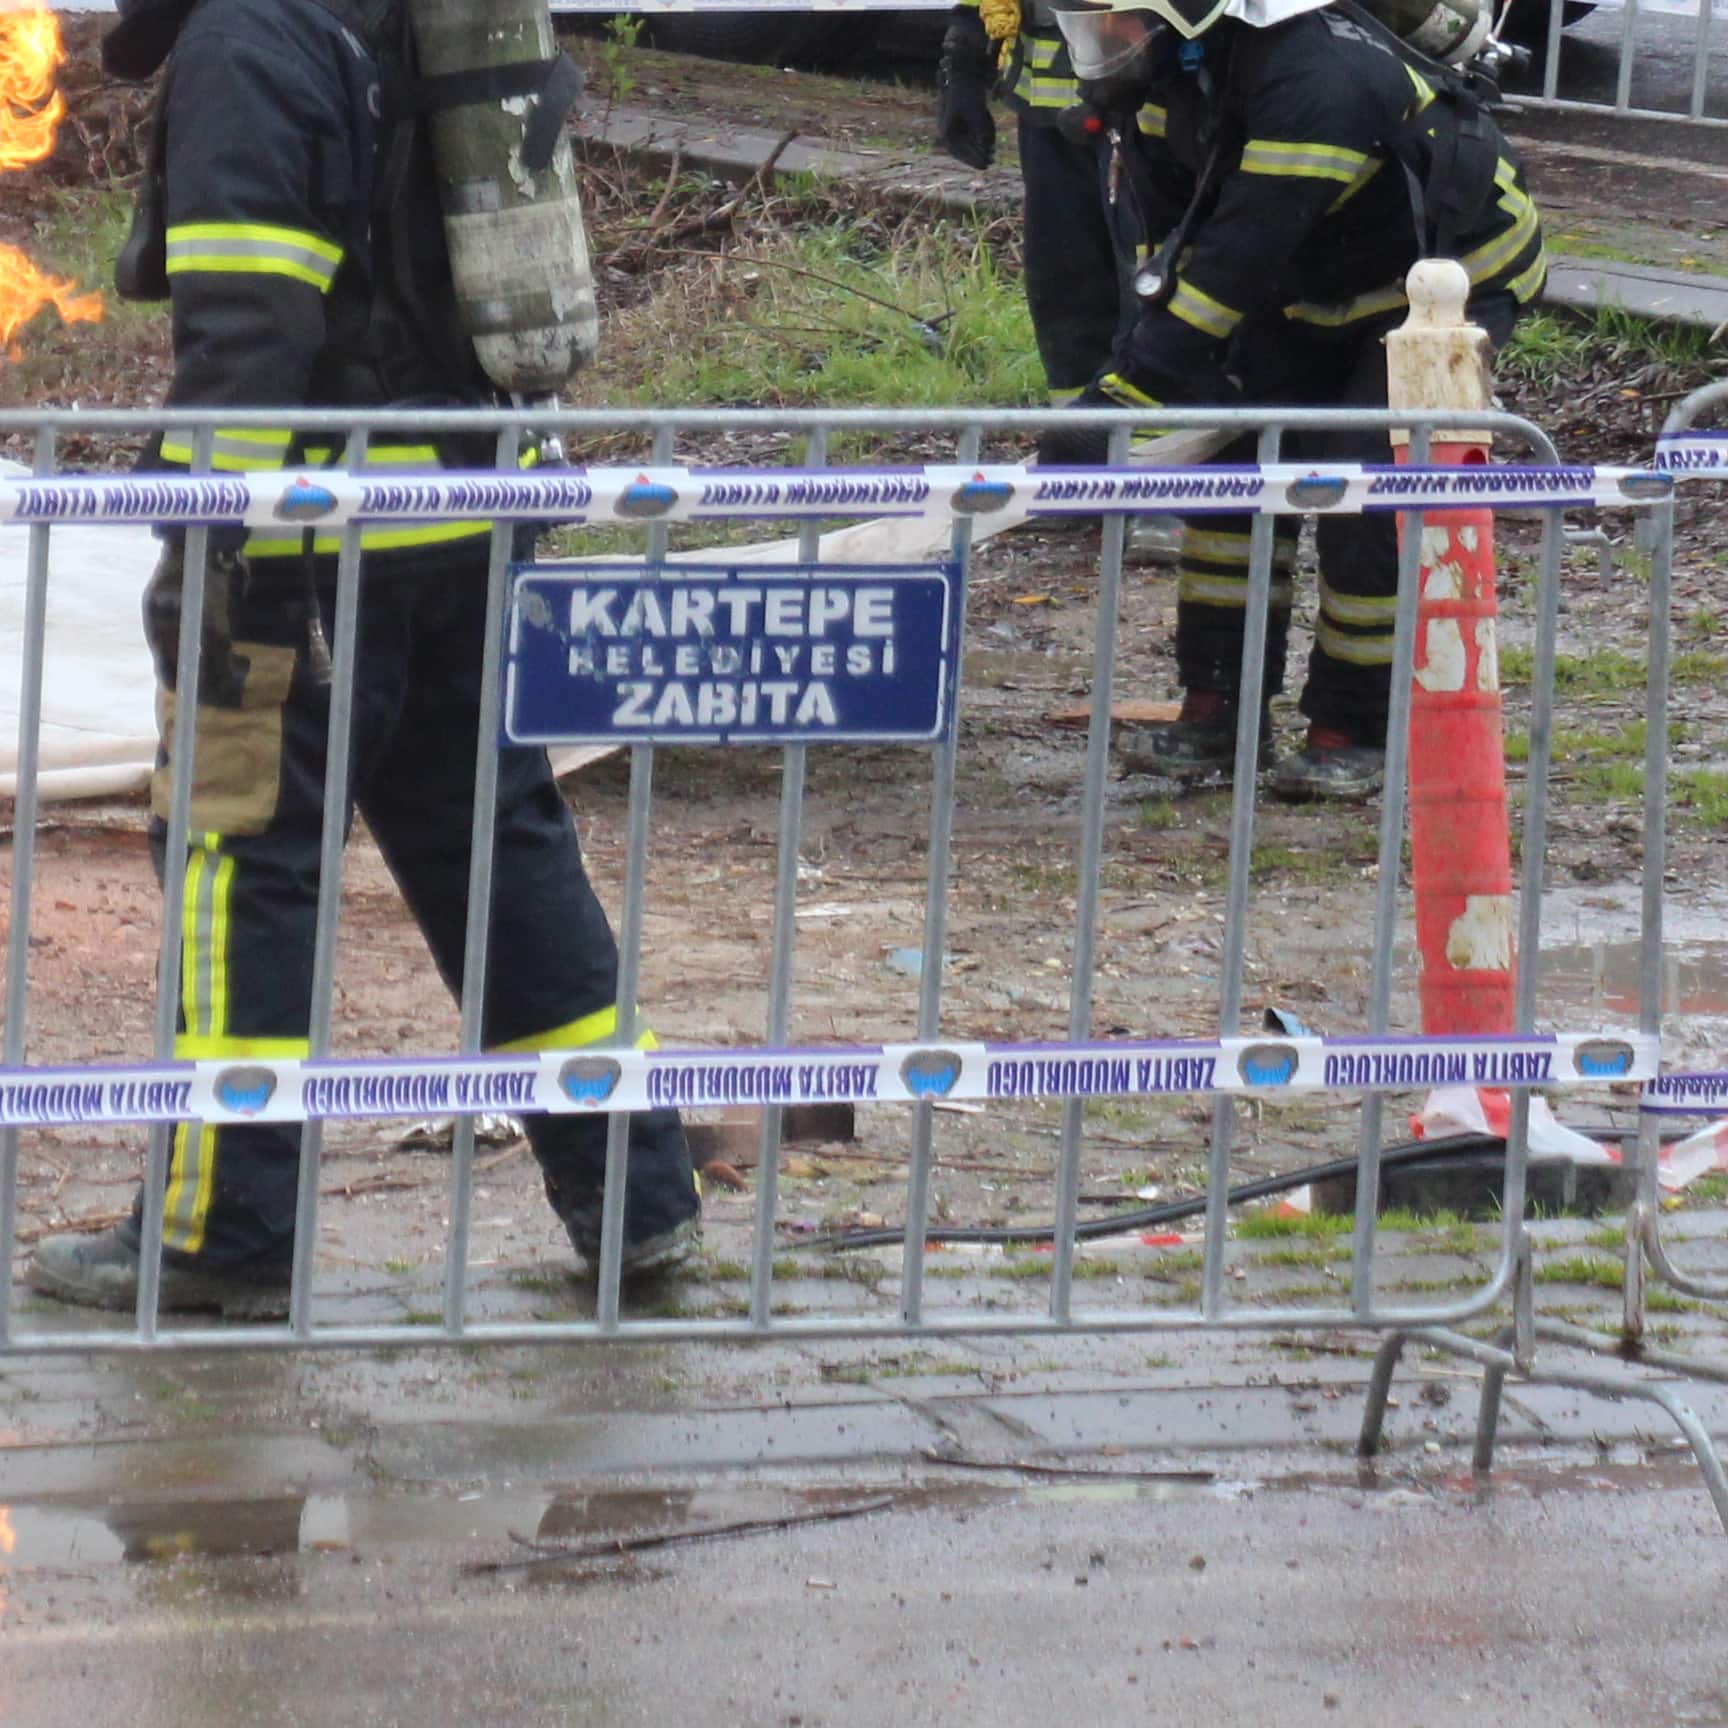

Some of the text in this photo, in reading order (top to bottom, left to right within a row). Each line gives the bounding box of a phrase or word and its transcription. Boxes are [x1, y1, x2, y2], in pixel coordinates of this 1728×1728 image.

[15, 486, 97, 517] ZABITA
[568, 587, 895, 638] KARTEPE
[611, 681, 839, 727] ZABITA
